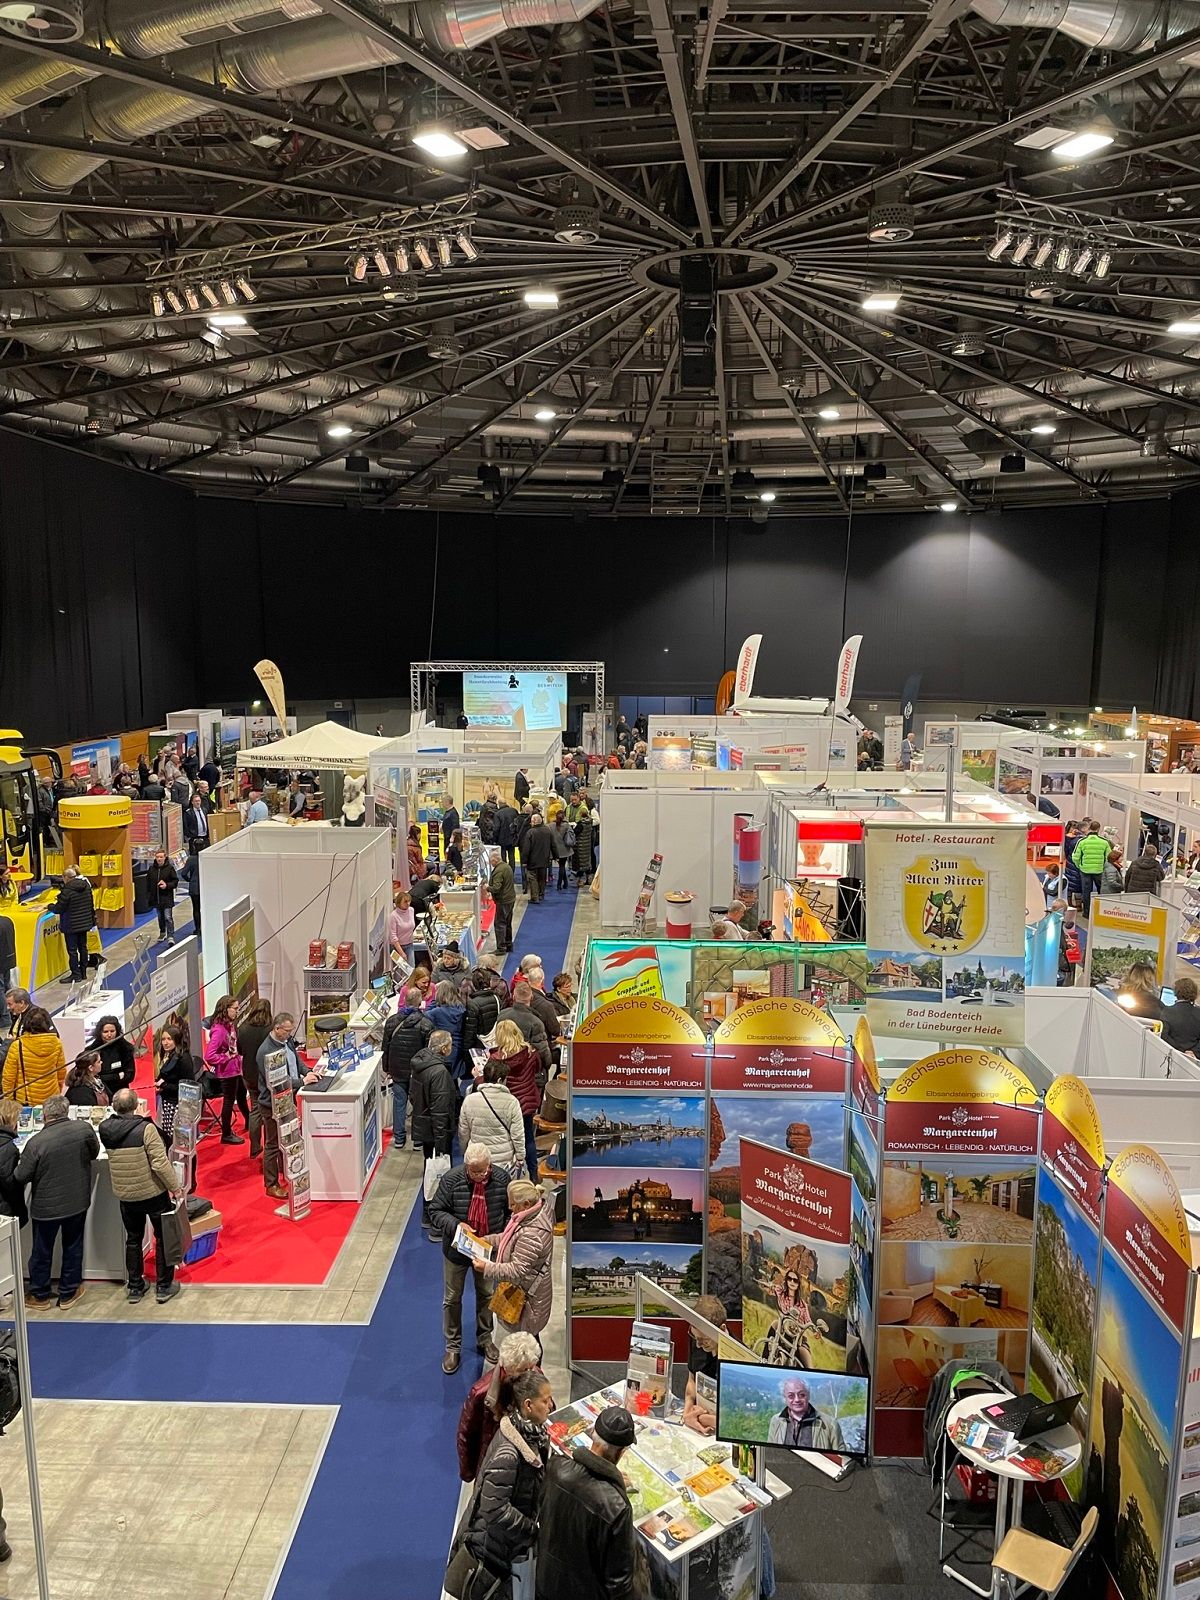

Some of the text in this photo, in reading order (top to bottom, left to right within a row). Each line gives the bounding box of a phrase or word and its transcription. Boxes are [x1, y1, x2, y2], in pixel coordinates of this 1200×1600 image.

[740, 646, 753, 692] eberhardt
[839, 648, 853, 697] eberhardt
[896, 834, 995, 844] Hotel Restaurant
[930, 858, 958, 872] Zum
[906, 874, 984, 885] Alten Ritter
[43, 924, 59, 937] Polst
[581, 1000, 696, 1038] Sächsische Schweiz
[721, 1001, 836, 1040] Sächsische Schweiz
[907, 1008, 982, 1021] Bad Bodenteich
[899, 1020, 914, 1028] der
[917, 1021, 972, 1034] Lüneburger
[974, 1026, 1002, 1035] Heide
[606, 1065, 671, 1076] Margaretenhof
[745, 1067, 810, 1078] Margaretenhof
[896, 1053, 974, 1095] Sächsische
[978, 1055, 1029, 1097] Schweiz
[923, 1127, 997, 1139] Margaretenhof
[989, 1143, 1033, 1152] NATÜRLICH
[764, 1168, 827, 1198] Park Hotel
[755, 1178, 832, 1220] Margaretenhof
[1115, 1149, 1187, 1249] Sächsische Schweiz
[785, 1209, 816, 1226] Sächsischen
[818, 1222, 843, 1237] Schweiz
